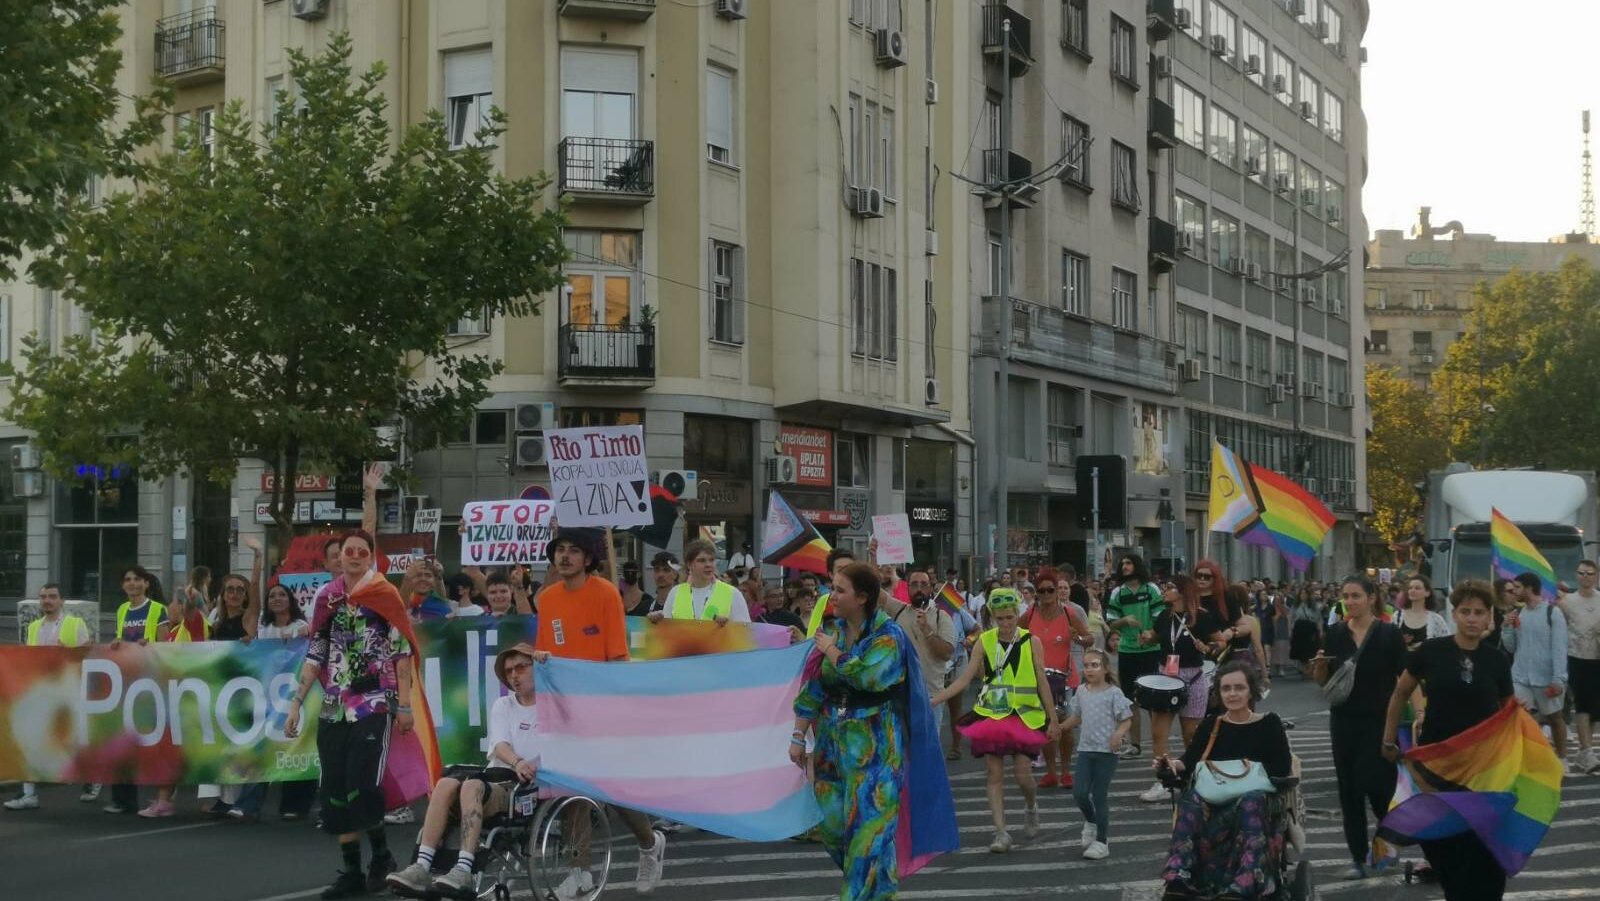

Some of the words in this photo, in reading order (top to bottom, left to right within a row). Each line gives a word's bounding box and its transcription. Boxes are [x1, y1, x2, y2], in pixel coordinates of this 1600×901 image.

[549, 435, 581, 461] Rio
[584, 433, 641, 459] Tinto
[800, 452, 825, 466] UPLATA
[552, 464, 593, 482] KOPAJ
[597, 462, 605, 478] U
[608, 460, 644, 478] SVOJA
[560, 484, 582, 515] 4
[586, 480, 647, 516] ZIDA!
[470, 504, 550, 524] STOP
[467, 524, 513, 542] IZVOZU
[470, 544, 483, 562] U
[488, 543, 548, 562] IZRAEL
[79, 658, 304, 747] Ponos
[275, 750, 322, 772] Beogra
